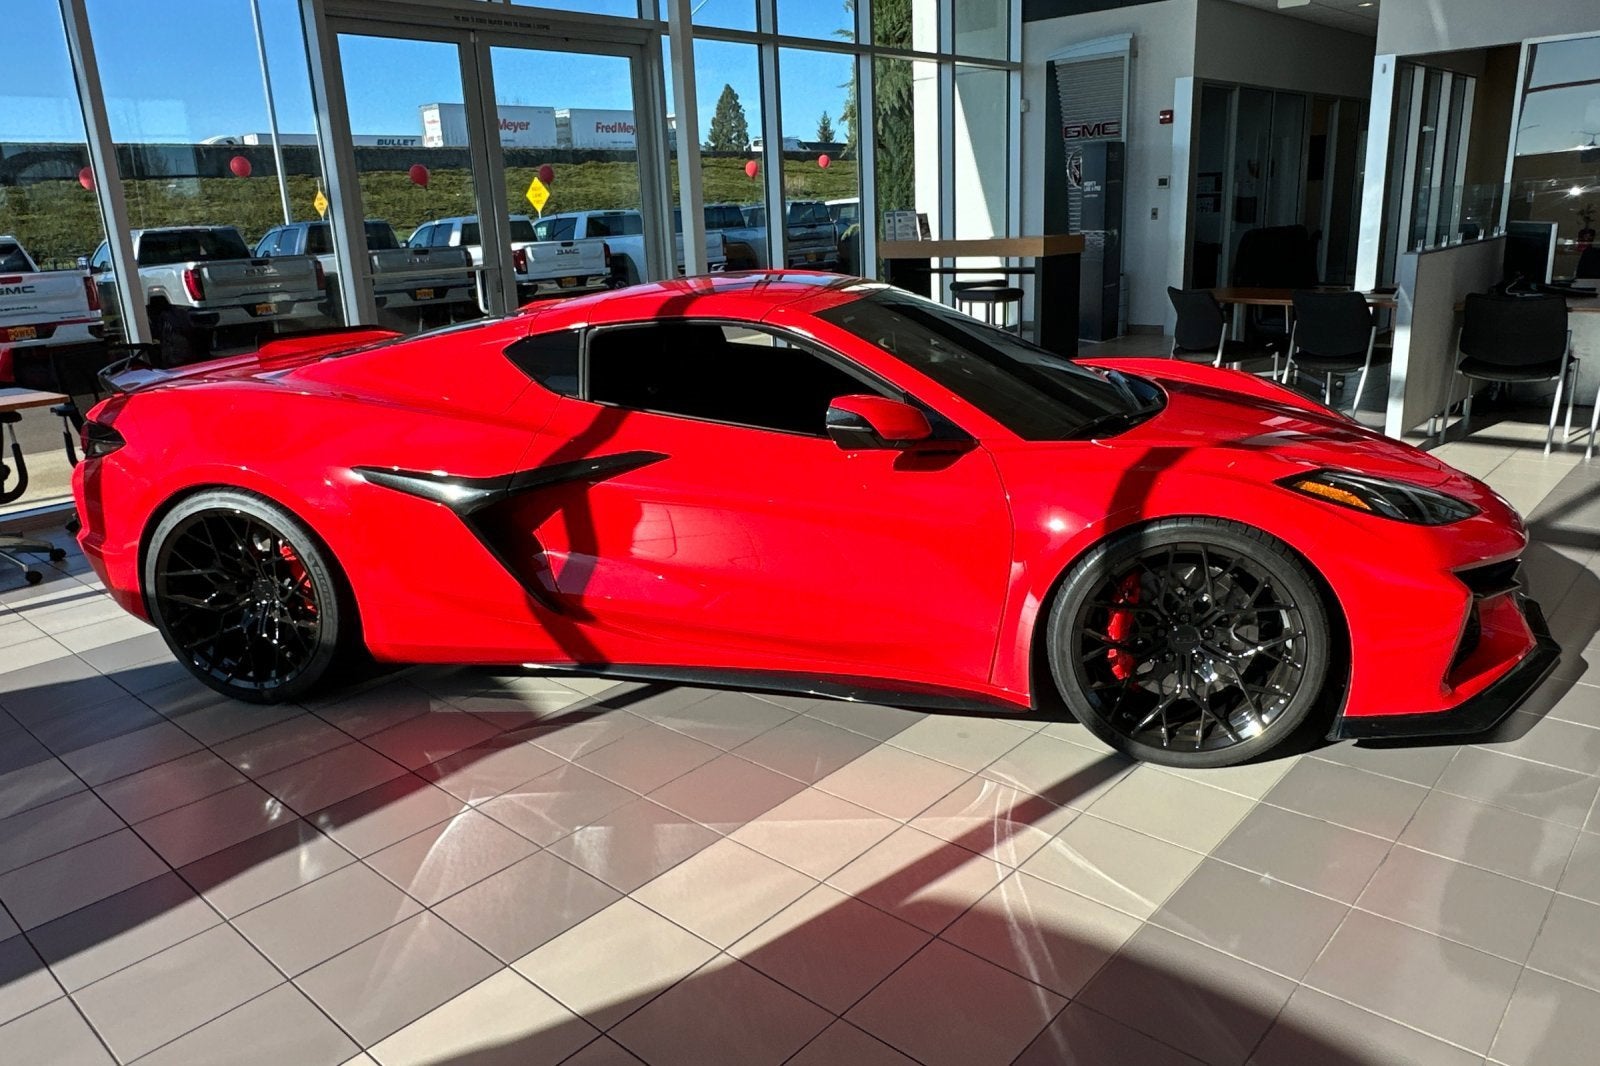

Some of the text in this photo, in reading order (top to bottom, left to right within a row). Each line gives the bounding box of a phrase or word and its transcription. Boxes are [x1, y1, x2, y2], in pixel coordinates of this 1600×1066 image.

[498, 118, 530, 133] Meyer
[1064, 121, 1120, 139] GMC
[377, 138, 416, 146] BULLET
[0, 285, 36, 295] MC
